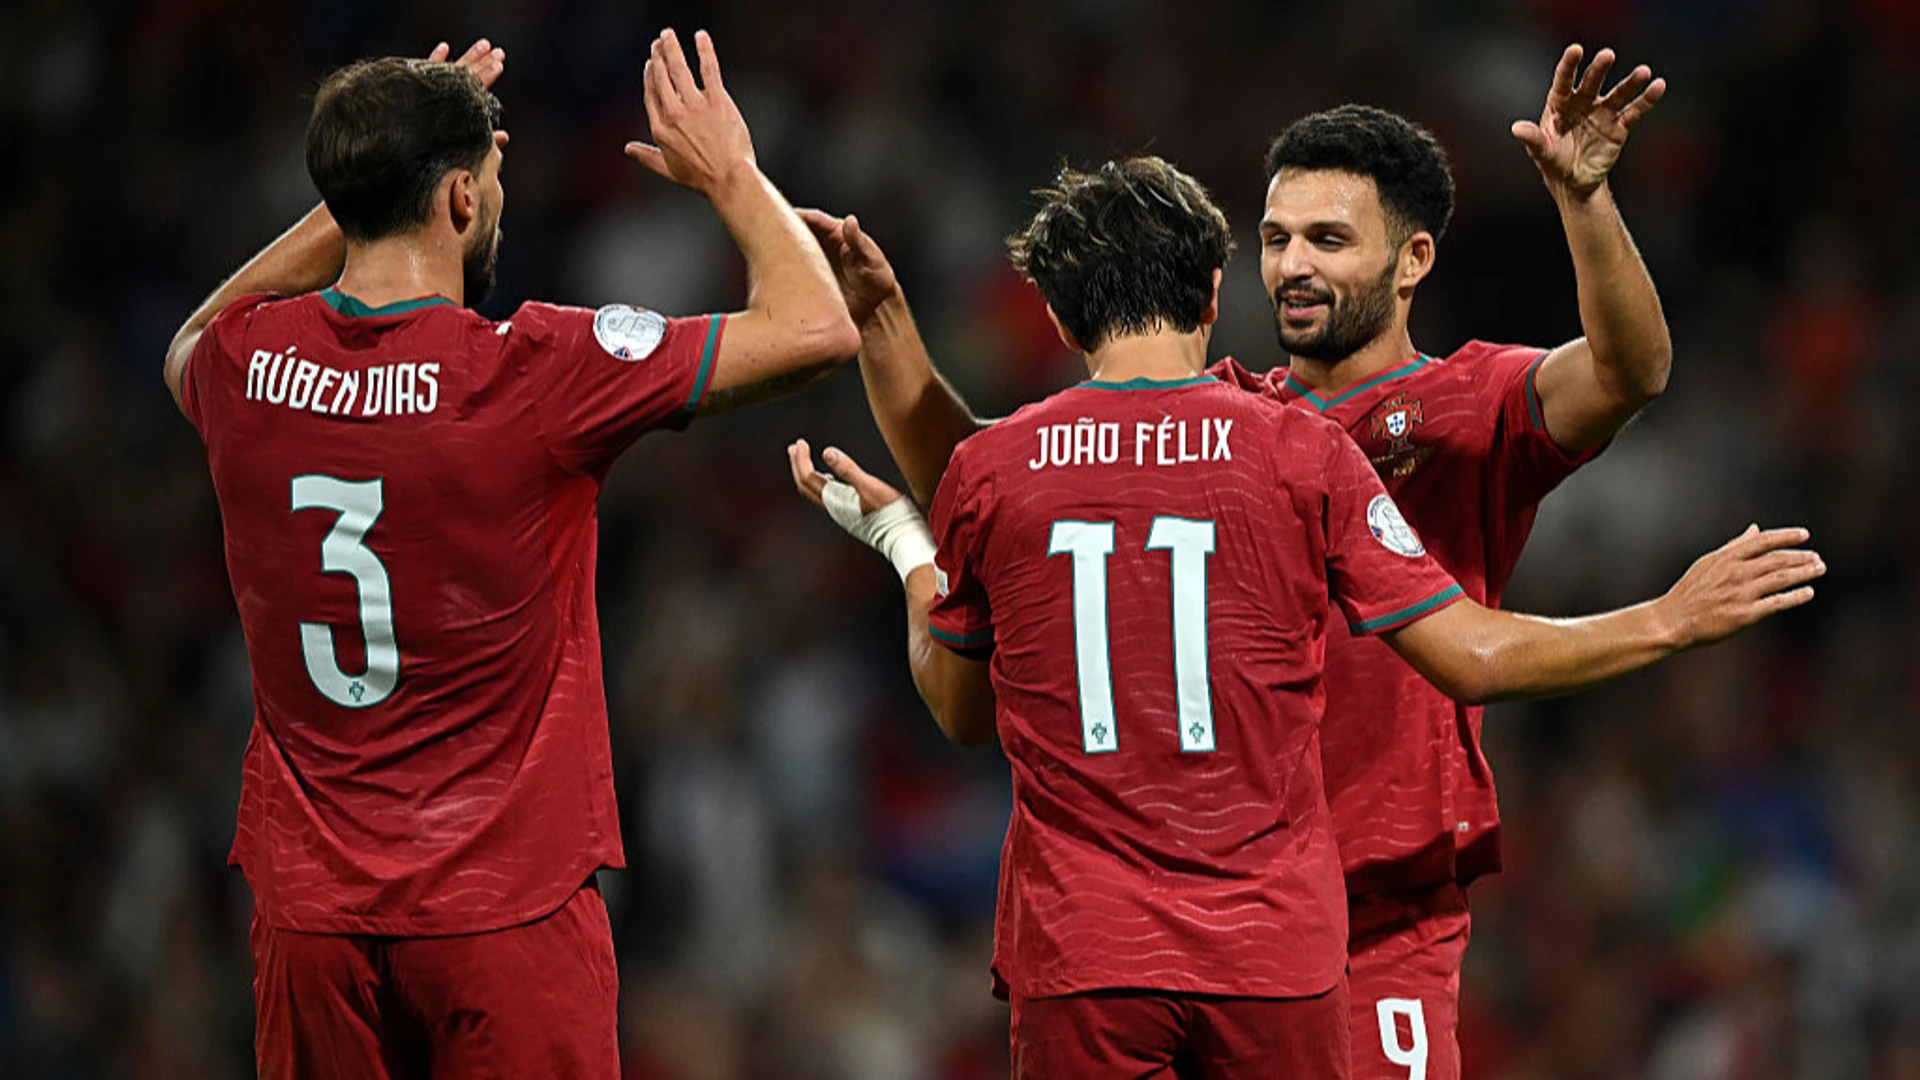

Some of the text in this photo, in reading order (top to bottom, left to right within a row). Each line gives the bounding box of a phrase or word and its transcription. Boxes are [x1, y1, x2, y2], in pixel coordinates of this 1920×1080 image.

[246, 346, 440, 416] RÚBEN DIAS
[1028, 414, 1234, 470] JOÃO FÉLIX
[291, 474, 399, 708] 3
[1047, 515, 1216, 755] 11
[1375, 997, 1429, 1080] 9
